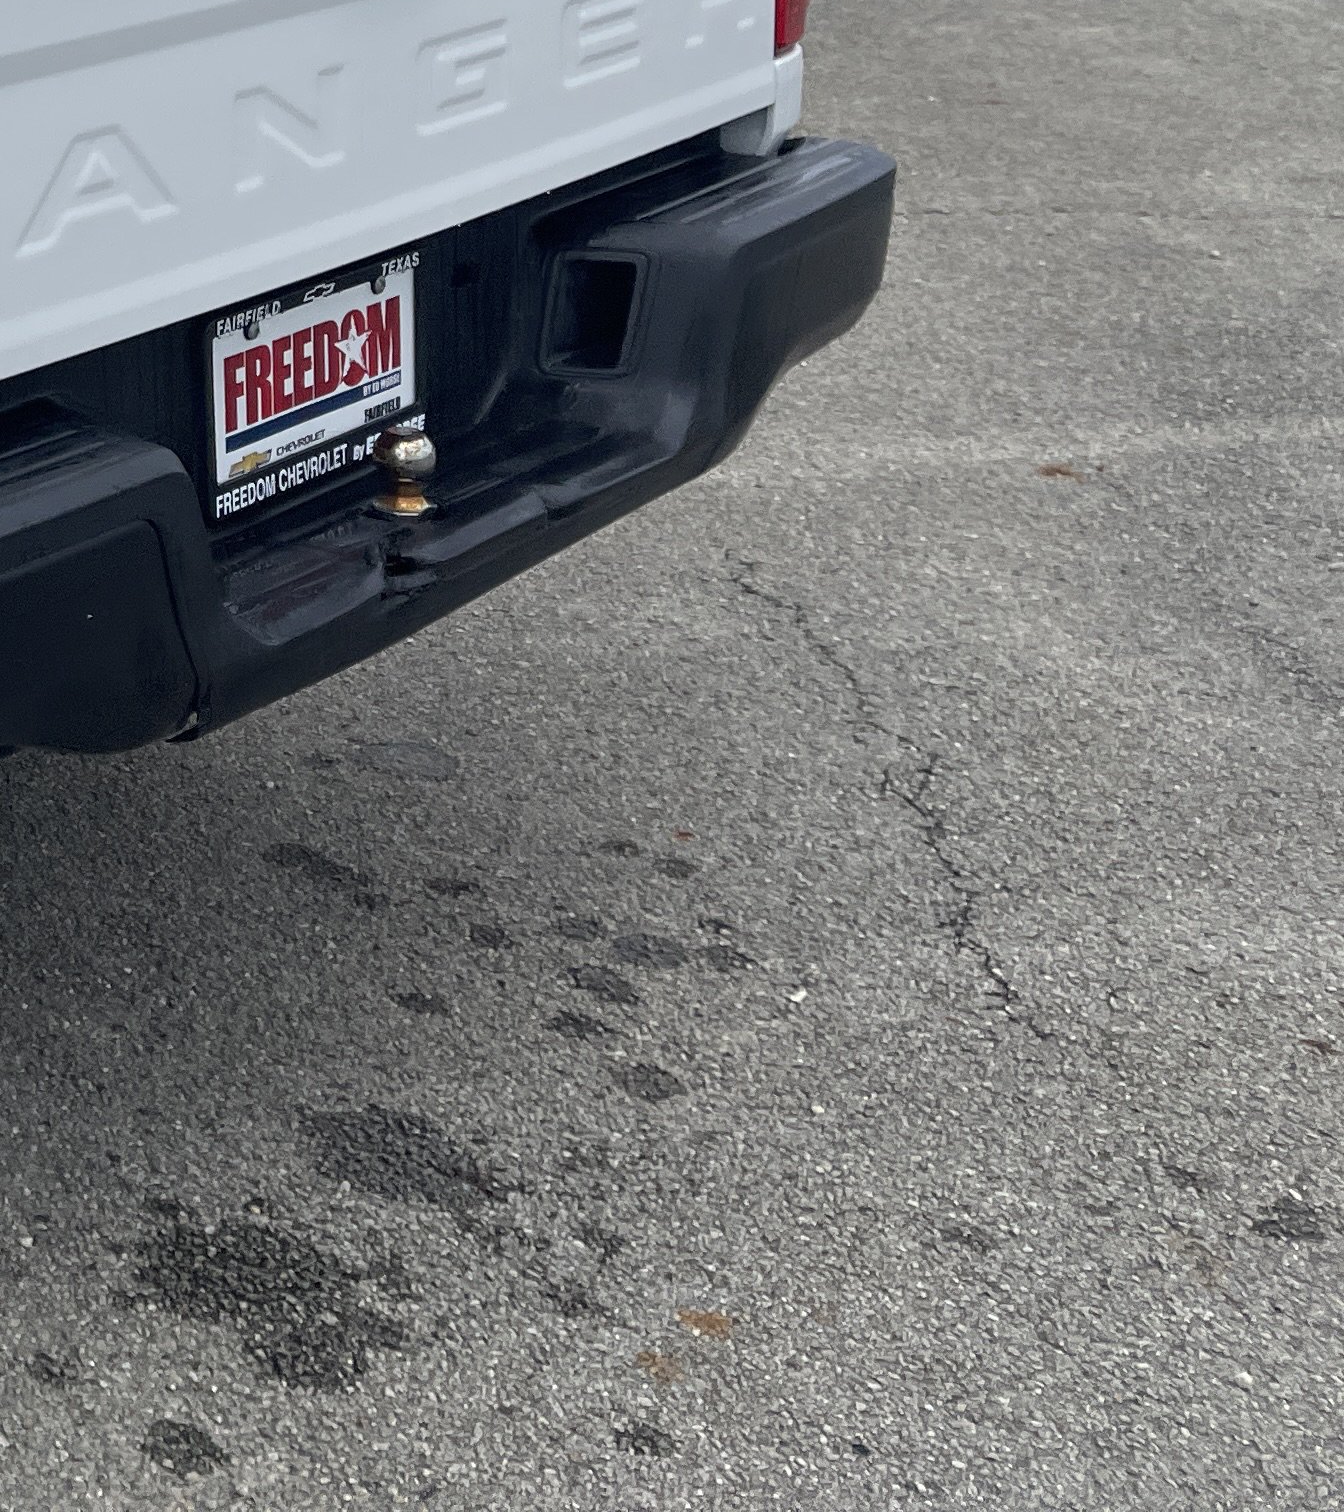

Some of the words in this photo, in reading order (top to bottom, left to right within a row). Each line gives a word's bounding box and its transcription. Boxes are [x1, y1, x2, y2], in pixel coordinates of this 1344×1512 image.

[216, 301, 281, 337] FAIRFIELD
[382, 252, 420, 277] TEXAS
[223, 295, 401, 434] FREEDOM
[216, 473, 276, 519] FREEDOM
[278, 443, 348, 492] CHEVROLET
[276, 429, 325, 457] CHEVROLET
